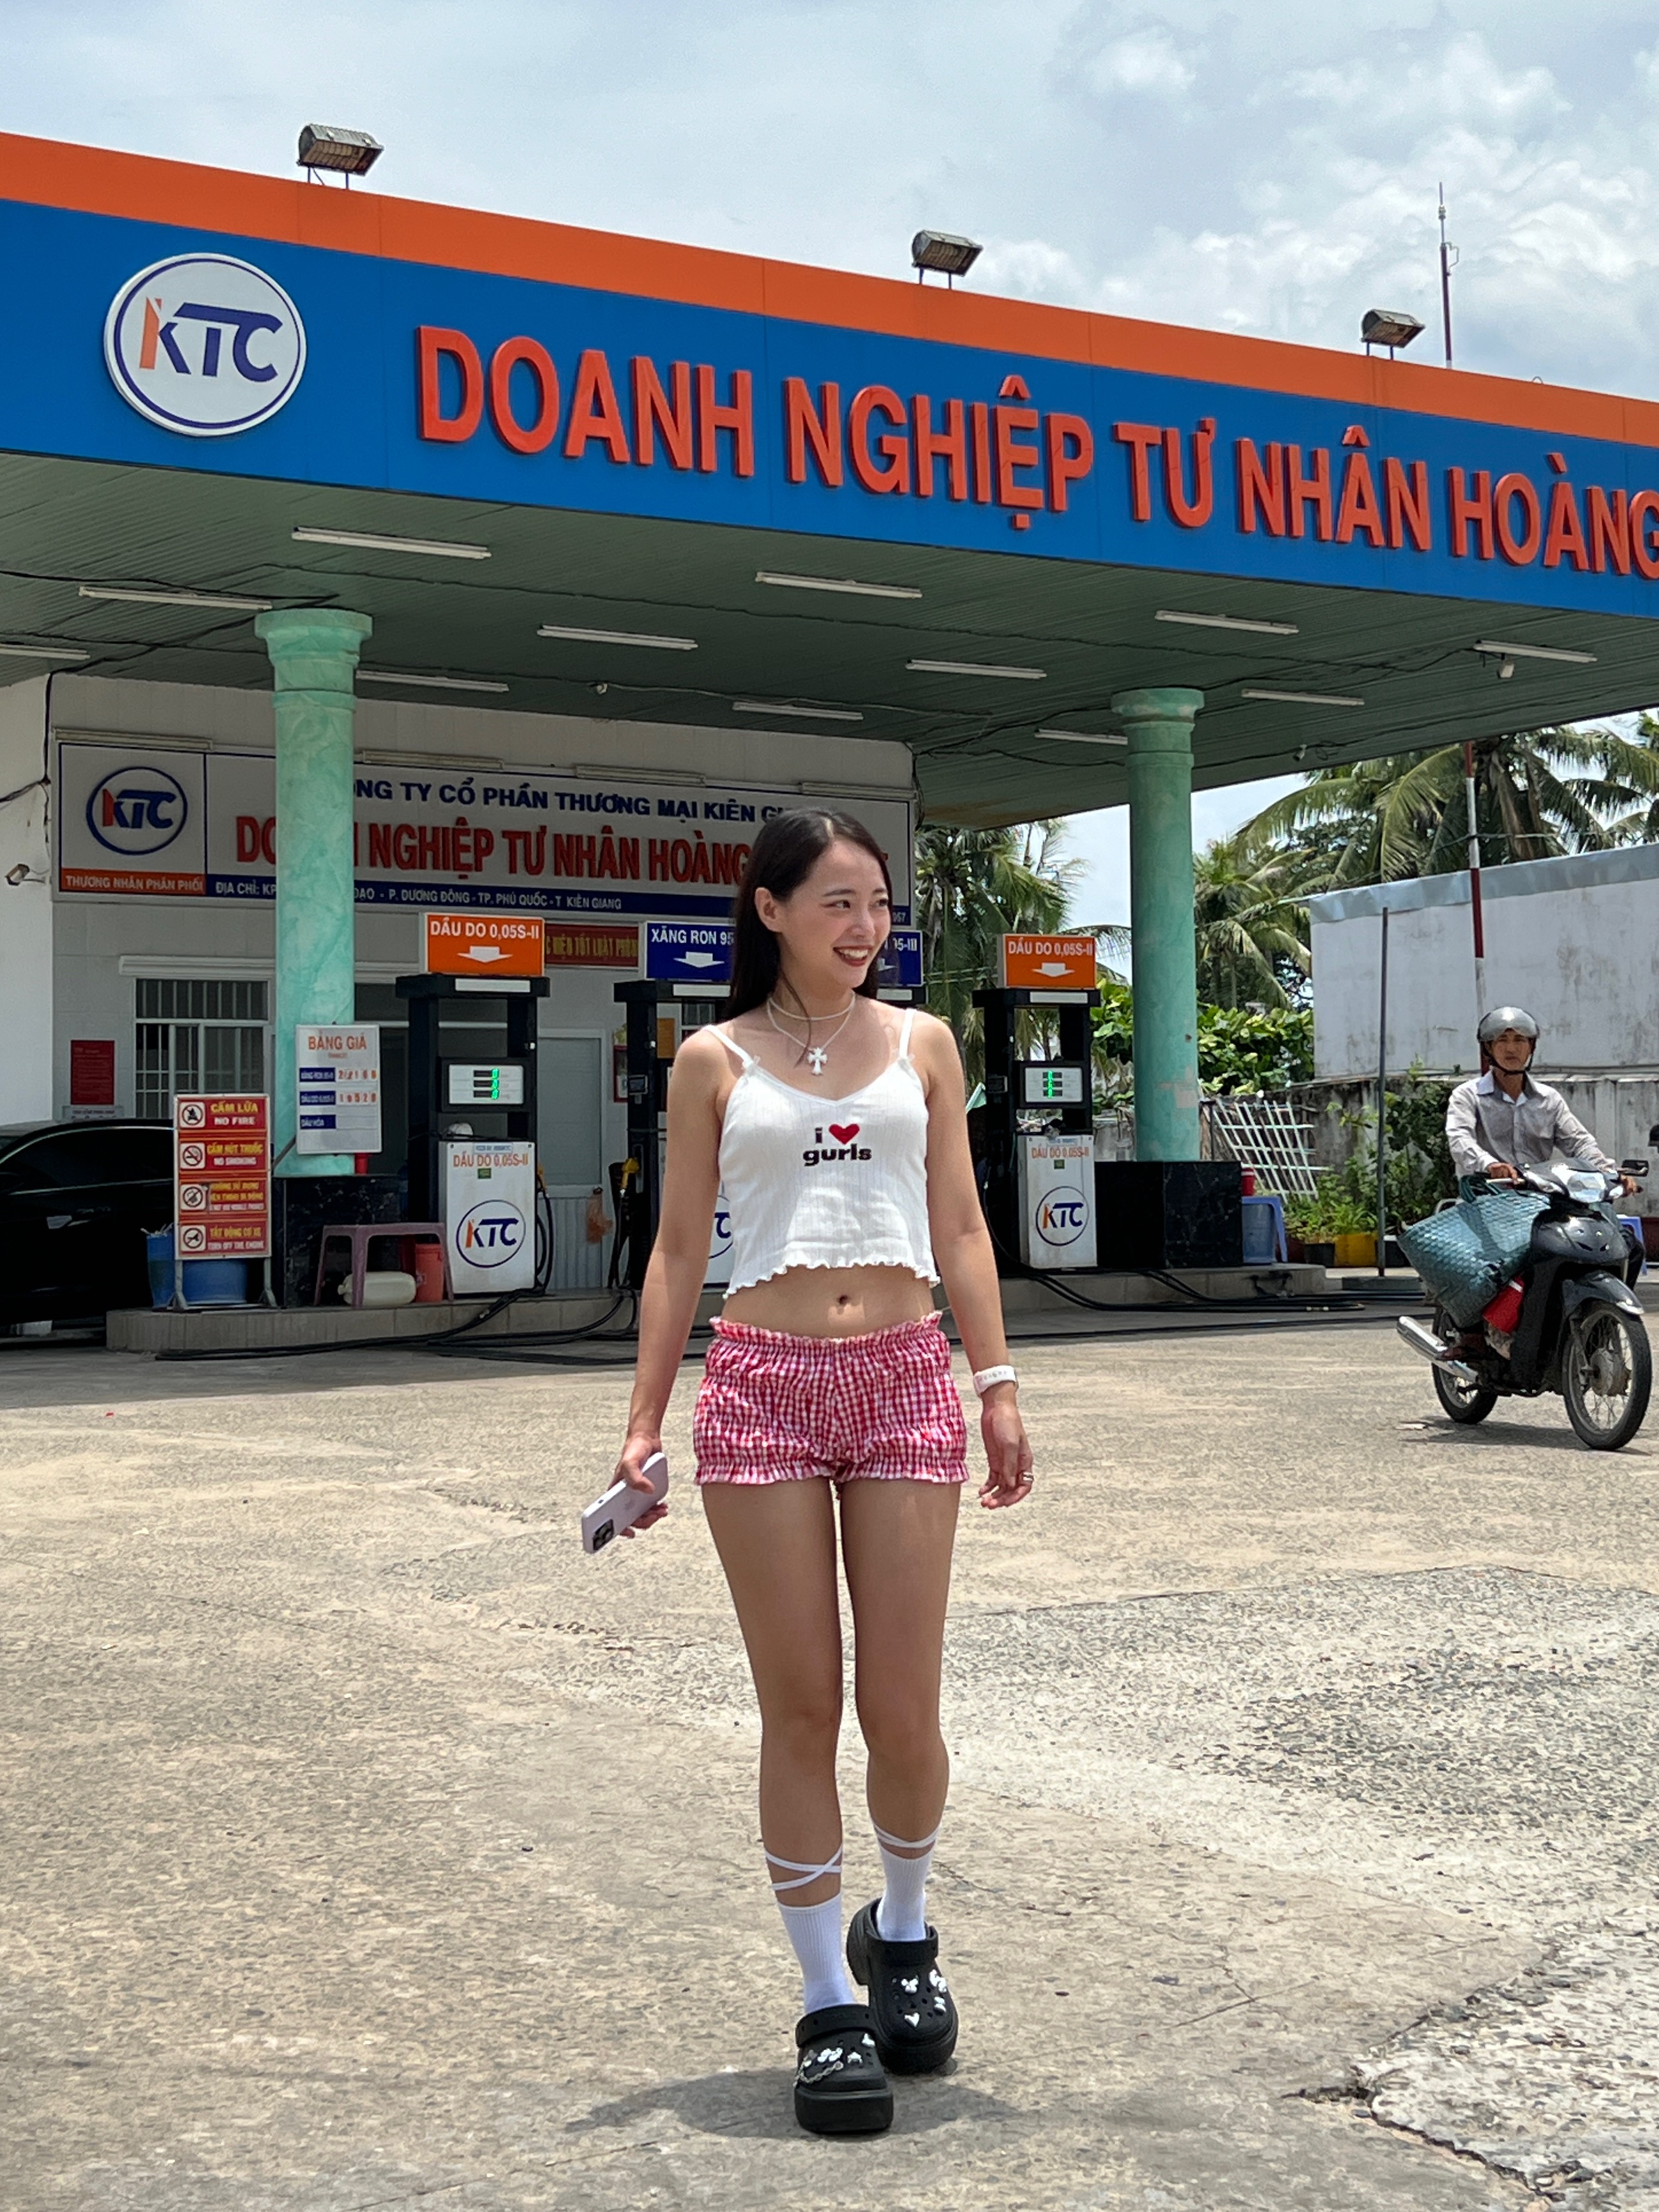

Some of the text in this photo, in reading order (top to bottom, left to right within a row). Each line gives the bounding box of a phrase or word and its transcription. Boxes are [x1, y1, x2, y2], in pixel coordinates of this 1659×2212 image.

[139, 297, 283, 382] KTC
[416, 325, 1659, 580] DOANH NGHIỆP TƯ NHÂN HOÀNG
[103, 788, 176, 829] KTC
[354, 779, 393, 800] NG
[400, 782, 432, 802] TY
[439, 777, 476, 805] CỔ
[555, 792, 650, 816] THƯƠNG
[658, 799, 698, 824] MẠI
[705, 799, 755, 822] KIÊN
[369, 816, 494, 879] NGHIỆP
[502, 825, 547, 875] TƯ
[553, 825, 640, 880] NHÂN
[649, 830, 751, 885] HOÀNG
[66, 874, 110, 888] THƯƠNG
[113, 877, 144, 889] NHÂN
[519, 891, 548, 907] QUỐC
[465, 922, 486, 938] DO
[490, 924, 539, 940] 0,05S-II
[651, 925, 687, 943] XĂNG
[690, 929, 716, 945] RON
[1035, 942, 1052, 955] DO
[308, 1029, 367, 1050] BẢNG GIÁ
[814, 1127, 823, 1143] i
[477, 1154, 492, 1167] DO
[803, 1143, 873, 1166] gurls
[1042, 1202, 1084, 1229] KTC
[465, 1218, 520, 1249] KTC
